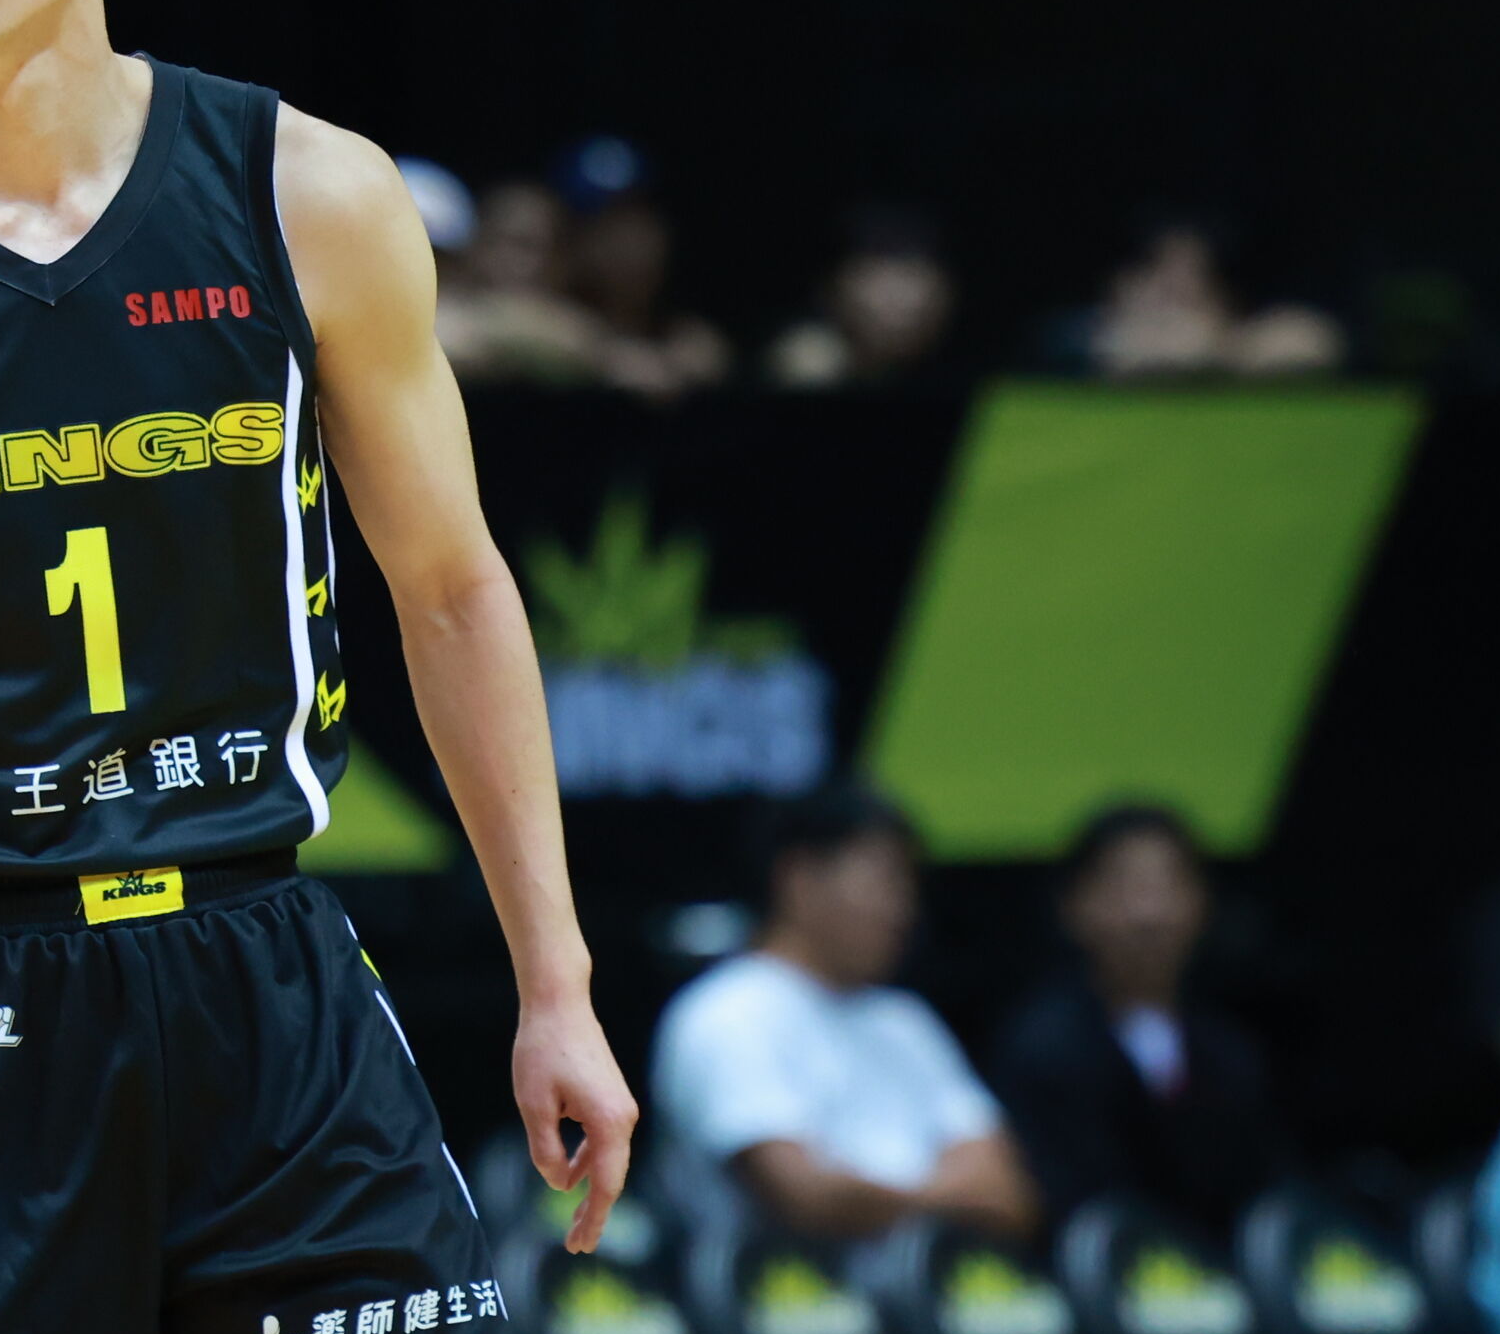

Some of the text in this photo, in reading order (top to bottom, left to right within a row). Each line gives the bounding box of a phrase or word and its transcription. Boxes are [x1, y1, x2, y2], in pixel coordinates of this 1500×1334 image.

[125, 285, 251, 327] SAMPO
[45, 526, 126, 714] 1
[11, 730, 268, 816] 王道銀行
[102, 881, 166, 901] KINGS
